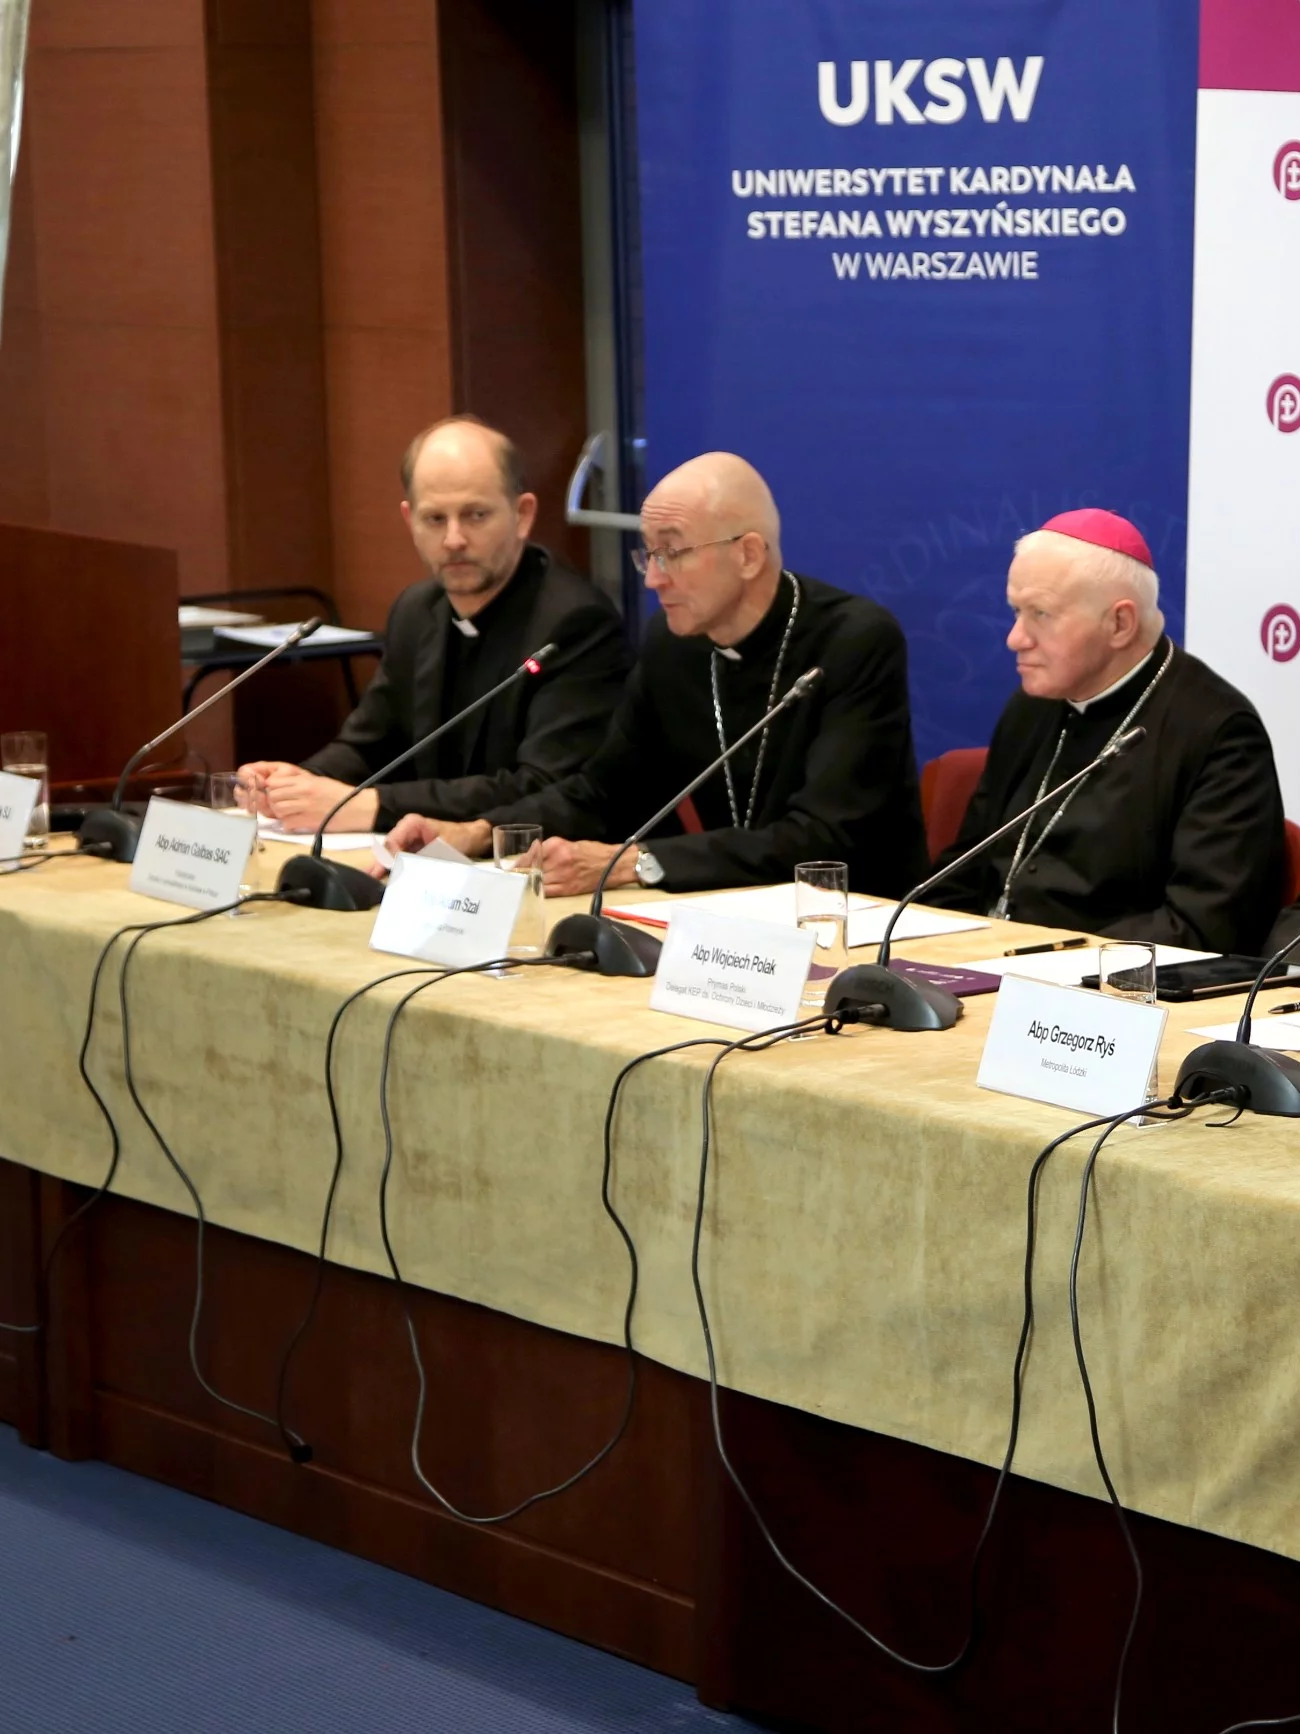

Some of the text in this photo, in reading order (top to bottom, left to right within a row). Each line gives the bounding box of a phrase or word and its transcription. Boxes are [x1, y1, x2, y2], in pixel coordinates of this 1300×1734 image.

[818, 56, 1044, 126] UKSW
[732, 164, 1136, 196] UNIWERSYTET KARDYNAŁA
[747, 202, 1127, 239] STEFANA WYSZYŃSKIEGO
[833, 251, 1038, 280] W WARSZAWIE
[691, 944, 777, 976] Abp Wojciech Polak
[1027, 1020, 1116, 1059] Abp Grzegorz Ryś
